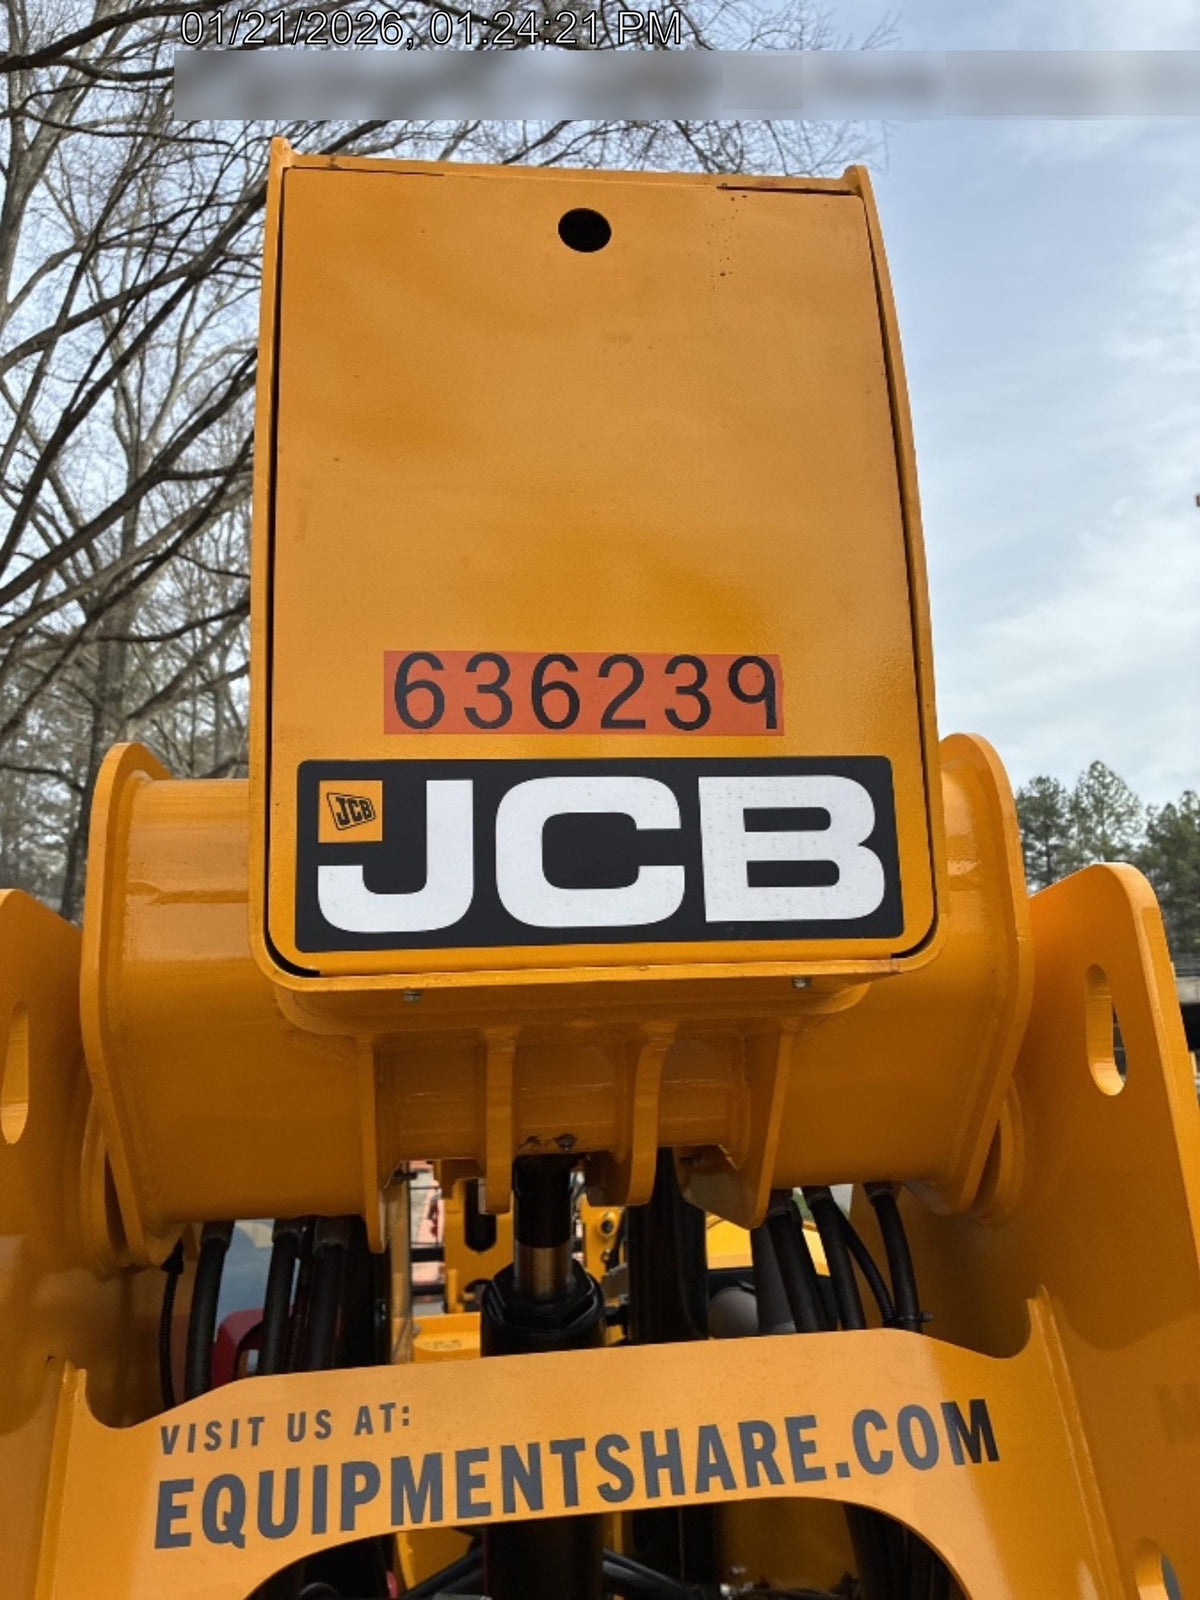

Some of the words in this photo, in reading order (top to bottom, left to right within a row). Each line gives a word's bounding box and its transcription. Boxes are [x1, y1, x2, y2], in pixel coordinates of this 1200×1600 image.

[394, 651, 778, 731] 636239
[336, 796, 372, 825] JCB
[318, 775, 885, 933] JCB
[161, 1416, 265, 1455] VISIT
[287, 1409, 331, 1442] US
[354, 1402, 410, 1435] AT:
[154, 1399, 999, 1549] EQUIPMENTSHARE.COM
